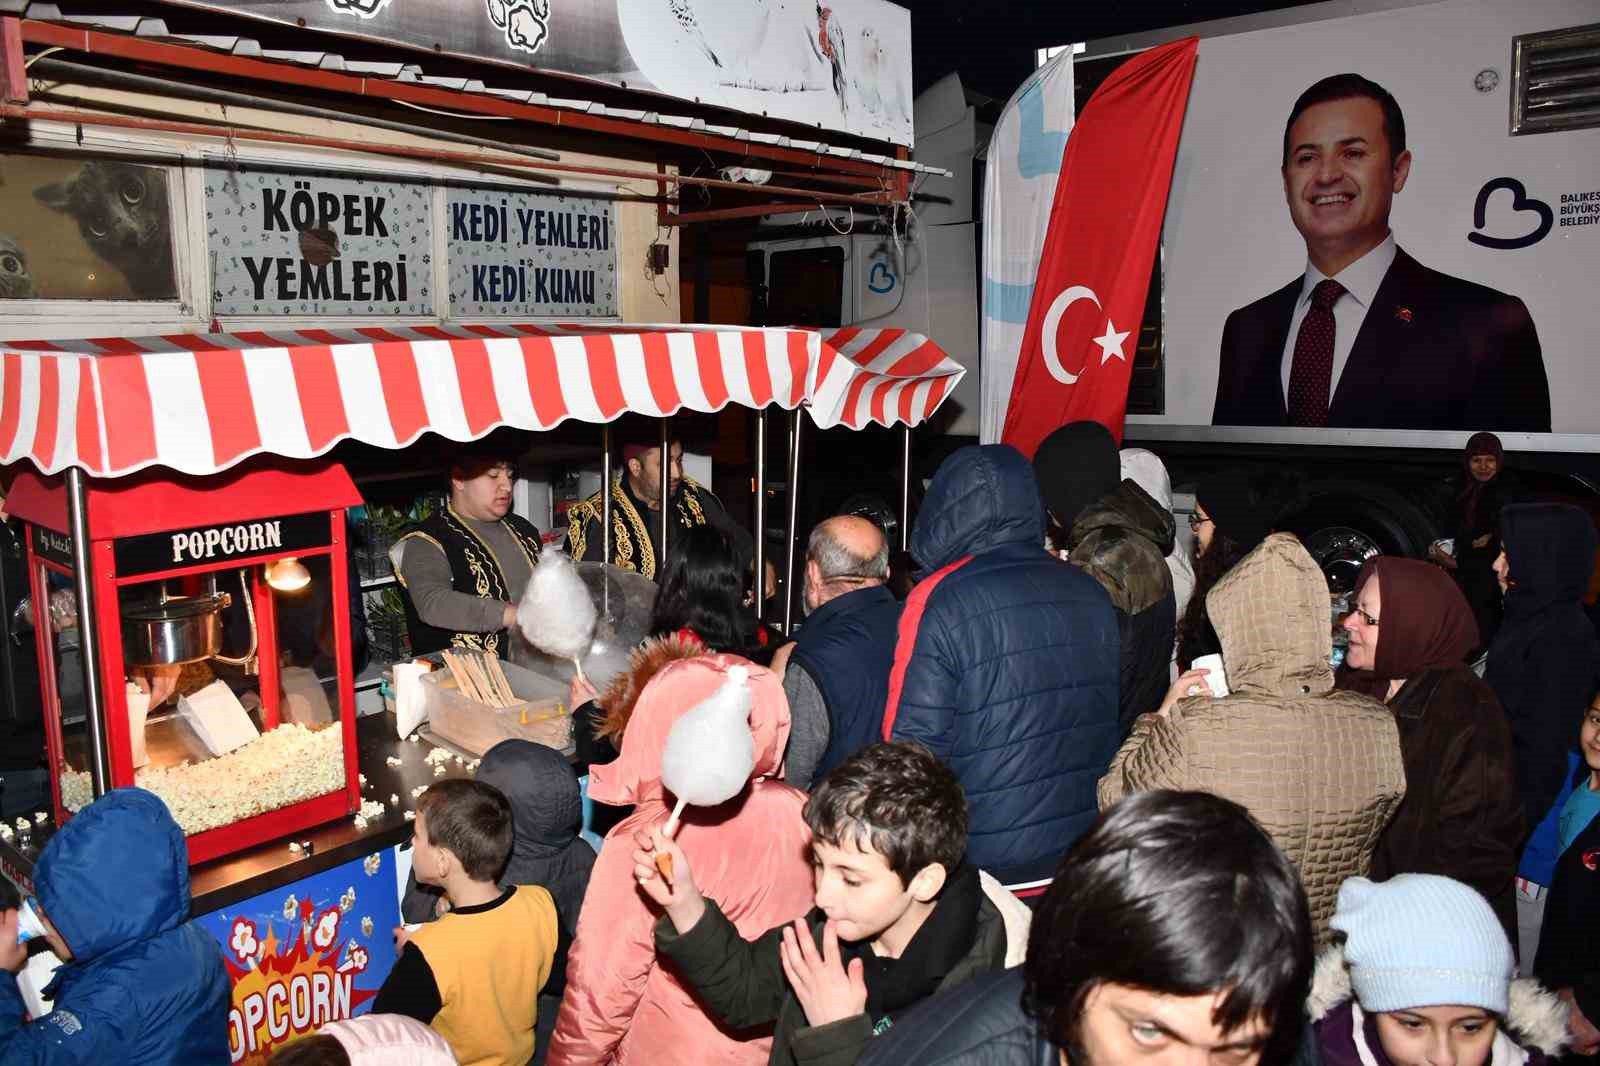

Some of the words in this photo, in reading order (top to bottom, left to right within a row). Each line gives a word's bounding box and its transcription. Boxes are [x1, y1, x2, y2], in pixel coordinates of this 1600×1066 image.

[262, 181, 389, 237] KÖPEK
[1560, 192, 1600, 203] BALIKES
[452, 199, 508, 243] KEDİ
[516, 209, 609, 251] YEMLERİ
[241, 254, 408, 301] YEMLERİ
[472, 259, 527, 303] KEDİ
[535, 268, 596, 304] KUMU
[171, 521, 282, 562] POPCORN
[228, 972, 352, 1063] OPCORN
